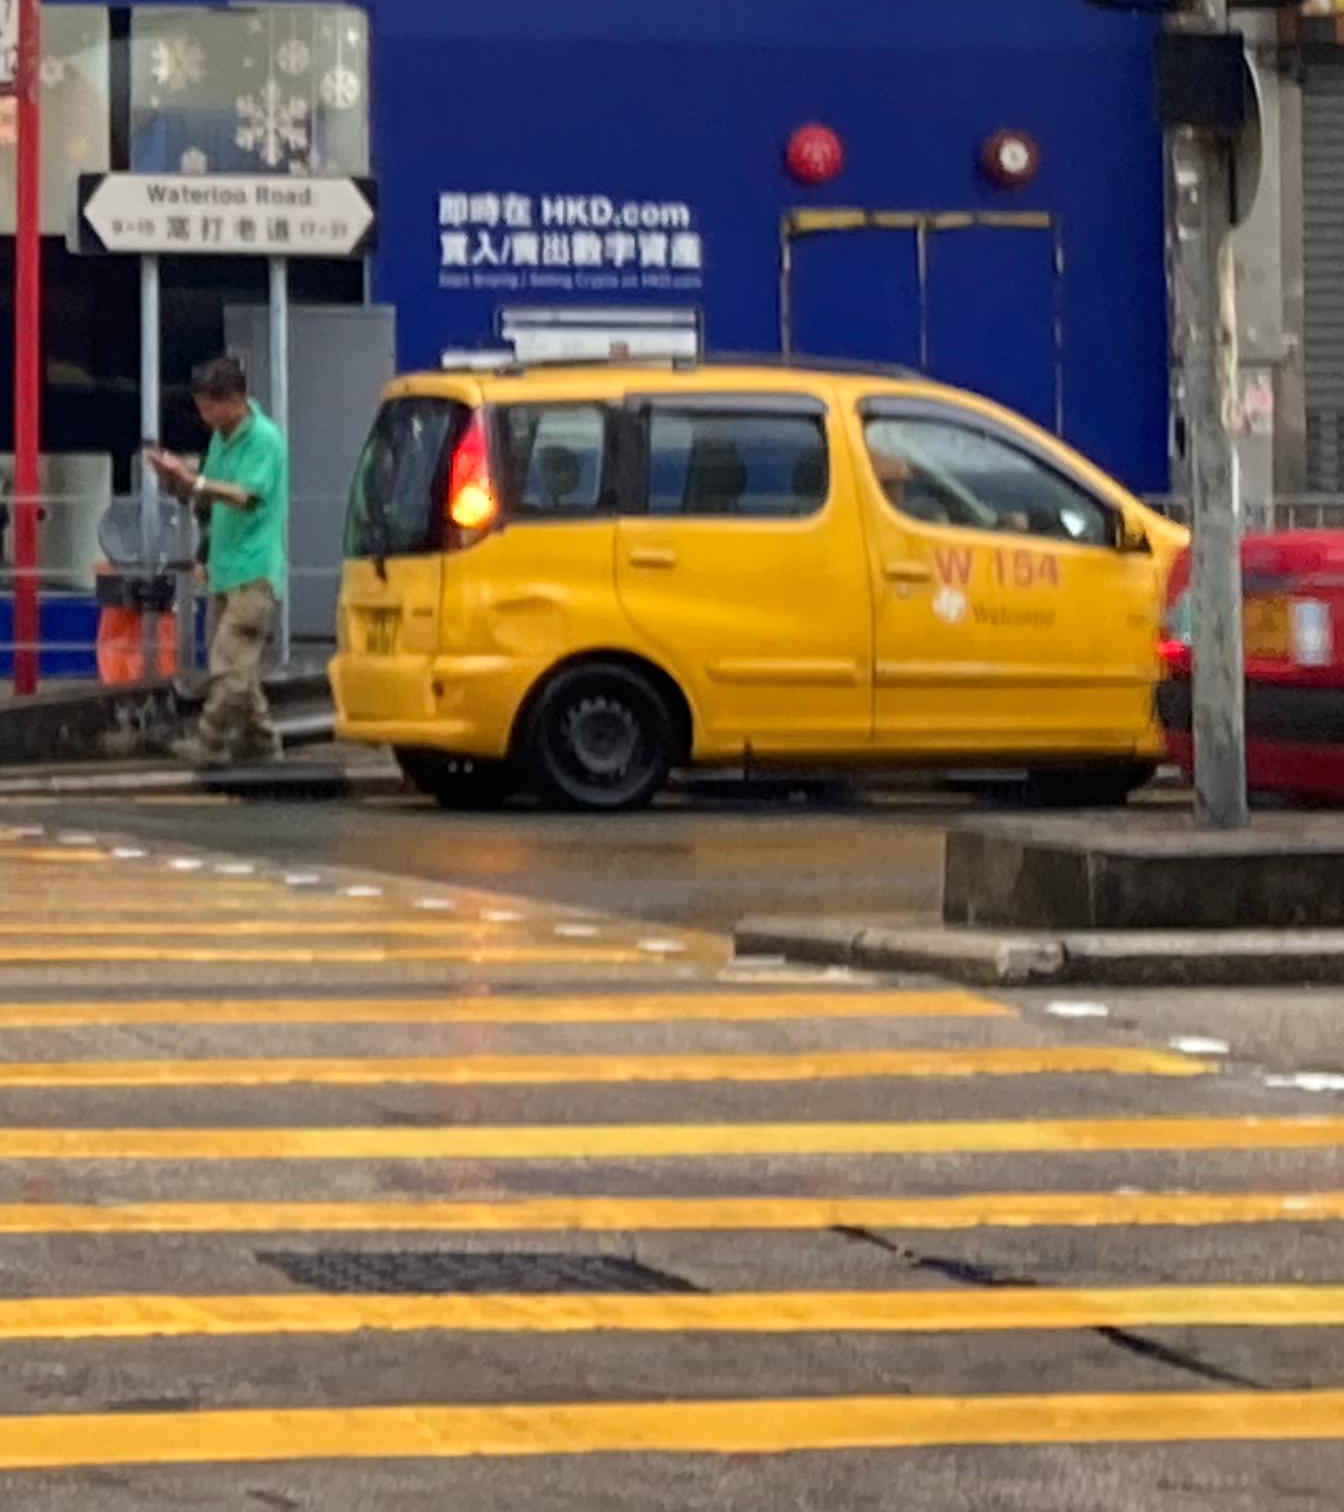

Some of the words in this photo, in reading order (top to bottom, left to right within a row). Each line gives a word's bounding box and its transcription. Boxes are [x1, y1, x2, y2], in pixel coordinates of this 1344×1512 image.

[146, 184, 247, 206] Waterloo
[255, 185, 312, 206] Road
[541, 194, 691, 228] HKD.com
